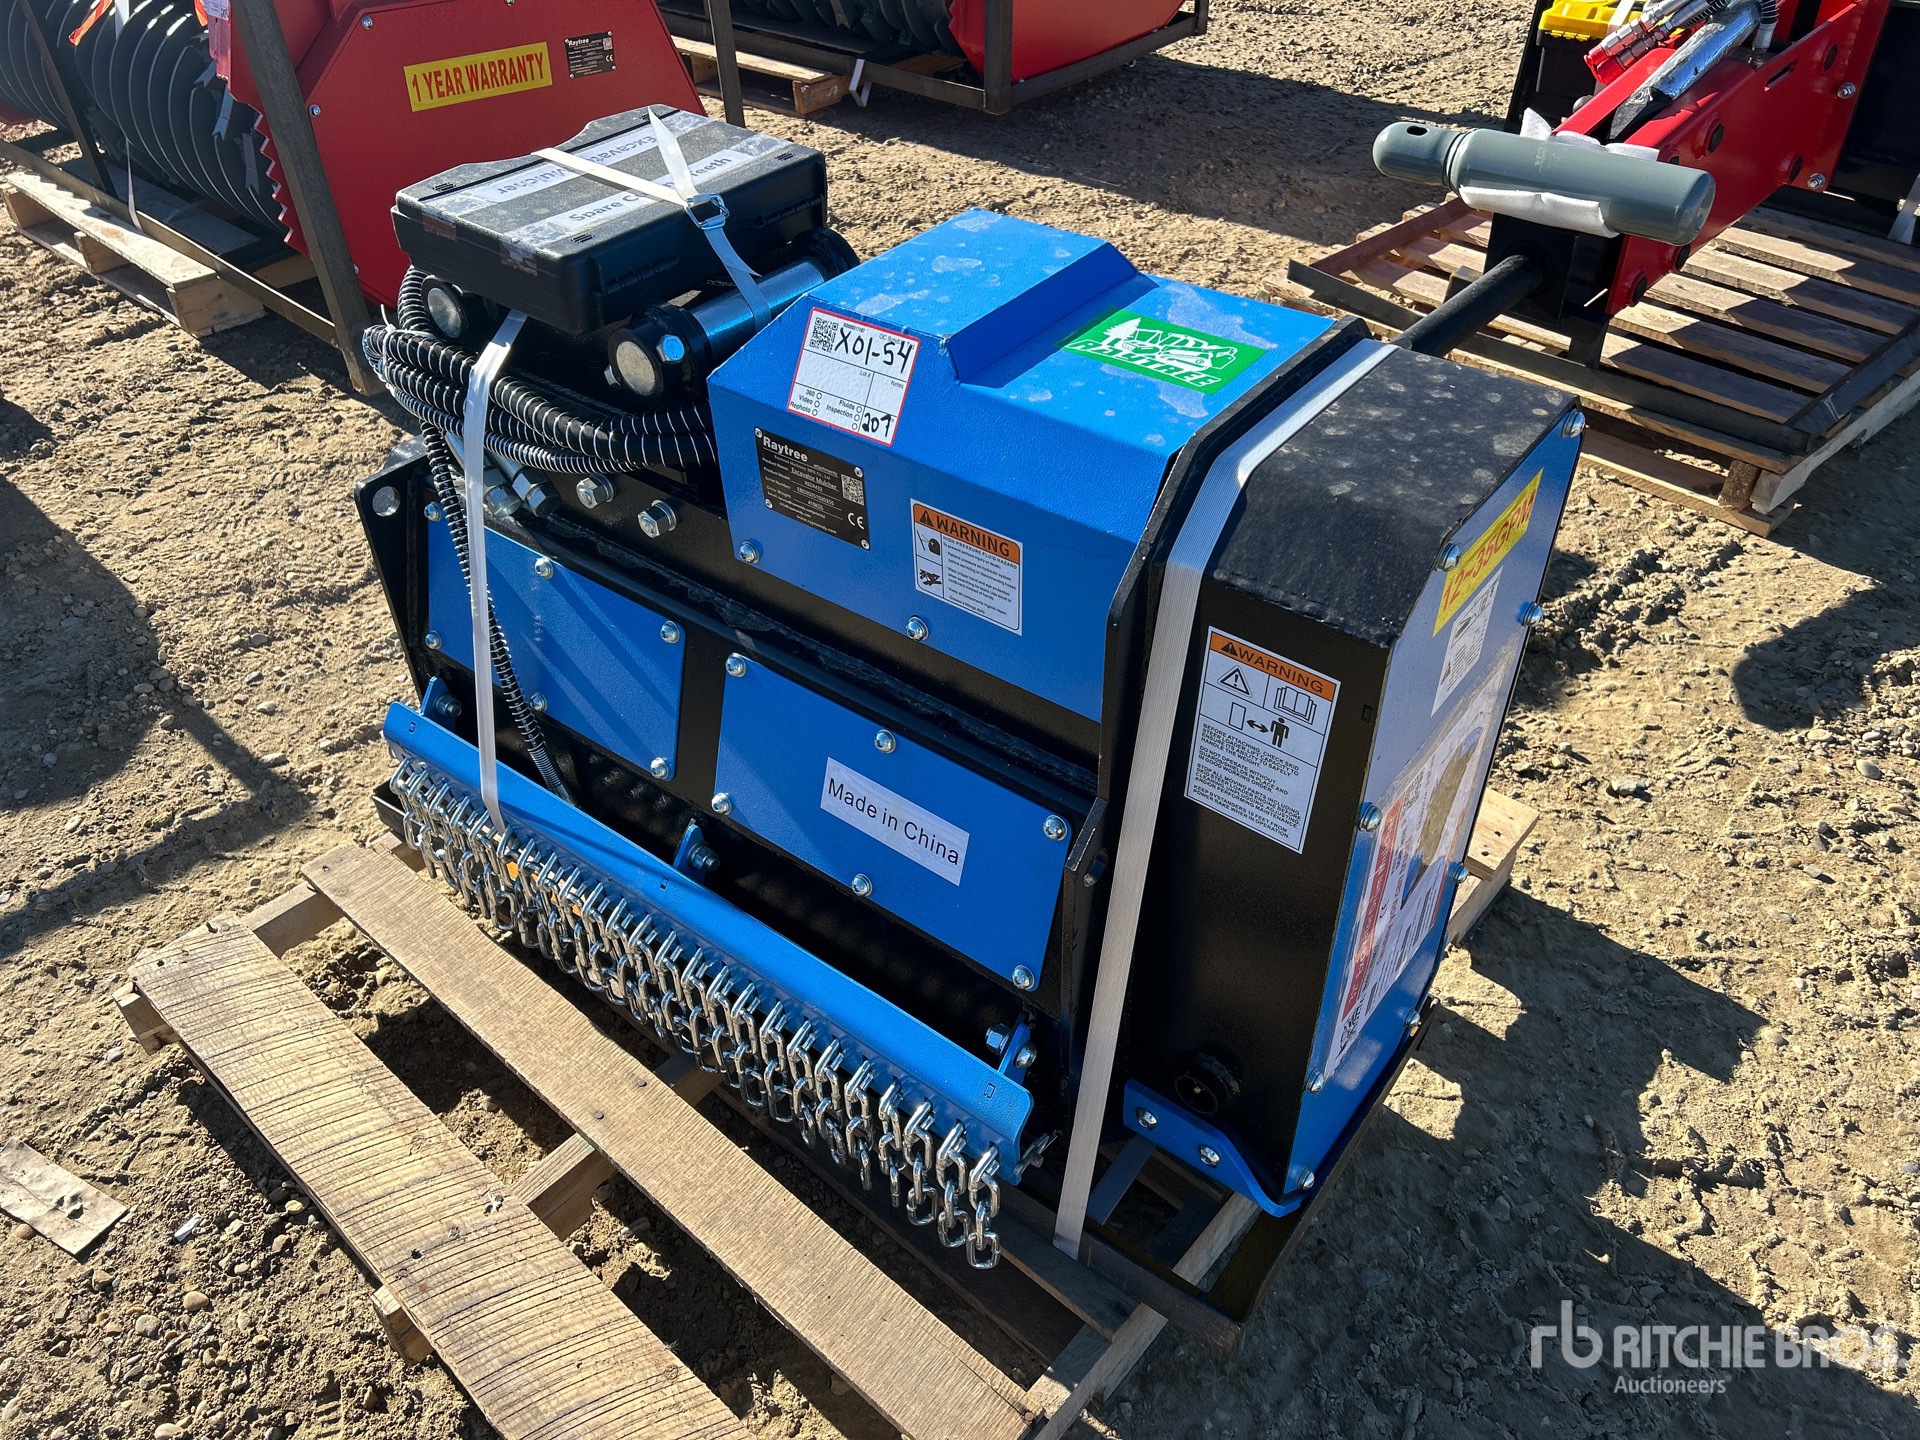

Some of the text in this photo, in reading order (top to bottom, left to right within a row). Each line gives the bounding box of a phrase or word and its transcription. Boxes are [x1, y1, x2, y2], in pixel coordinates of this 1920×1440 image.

[412, 74, 422, 102] 1
[423, 66, 466, 100] YEAR
[465, 51, 545, 93] WARRANTY
[569, 201, 621, 222] Spare
[1066, 338, 1222, 387] RAYTREE
[798, 394, 813, 404] Video
[890, 380, 904, 388] Notes
[789, 400, 811, 413] Rephoto
[825, 403, 853, 419] Inspection
[838, 399, 855, 410] Fluids
[762, 435, 808, 464] Raytree
[816, 476, 837, 490] Mulcher
[847, 510, 864, 530] CE
[936, 515, 1009, 557] WARNING
[1443, 488, 1538, 611] 12-35GPM
[1237, 647, 1324, 693] WARNING
[1200, 736, 1224, 751] HANDLE
[1225, 747, 1236, 757] THE
[1201, 731, 1291, 777] ENSURE ITS ABILITY TO SAFELY
[1202, 727, 1299, 776] STEER LOADER LIFT CAPACITY TO
[1203, 722, 1226, 737] BEFORE
[1262, 750, 1284, 764] CHECK
[1284, 760, 1299, 772] SKID
[1199, 744, 1276, 785] DO NOT OPERATE WITHOUT
[1204, 756, 1222, 769] GOOD
[1222, 765, 1250, 782] WORKING
[1196, 762, 1299, 815] STOP ALL MOVING PARTS INCLUDING
[1196, 766, 1301, 821] SKID STEER LOADER ENGINE BEFORE
[1216, 786, 1254, 808] PERFORMING
[1255, 776, 1274, 789] PLACE
[1275, 785, 1288, 796] AND
[1192, 788, 1213, 802] POWER
[1214, 798, 1228, 809] RAKE
[1230, 806, 1247, 818] WHEN
[1193, 783, 1208, 794] KEEP
[1209, 791, 1246, 813] BYSTANDERS
[1254, 813, 1269, 824] FEET
[1270, 821, 1287, 833] FROM
[828, 777, 959, 865] Made in China
[1393, 872, 1403, 901] can
[1388, 893, 1399, 924] you
